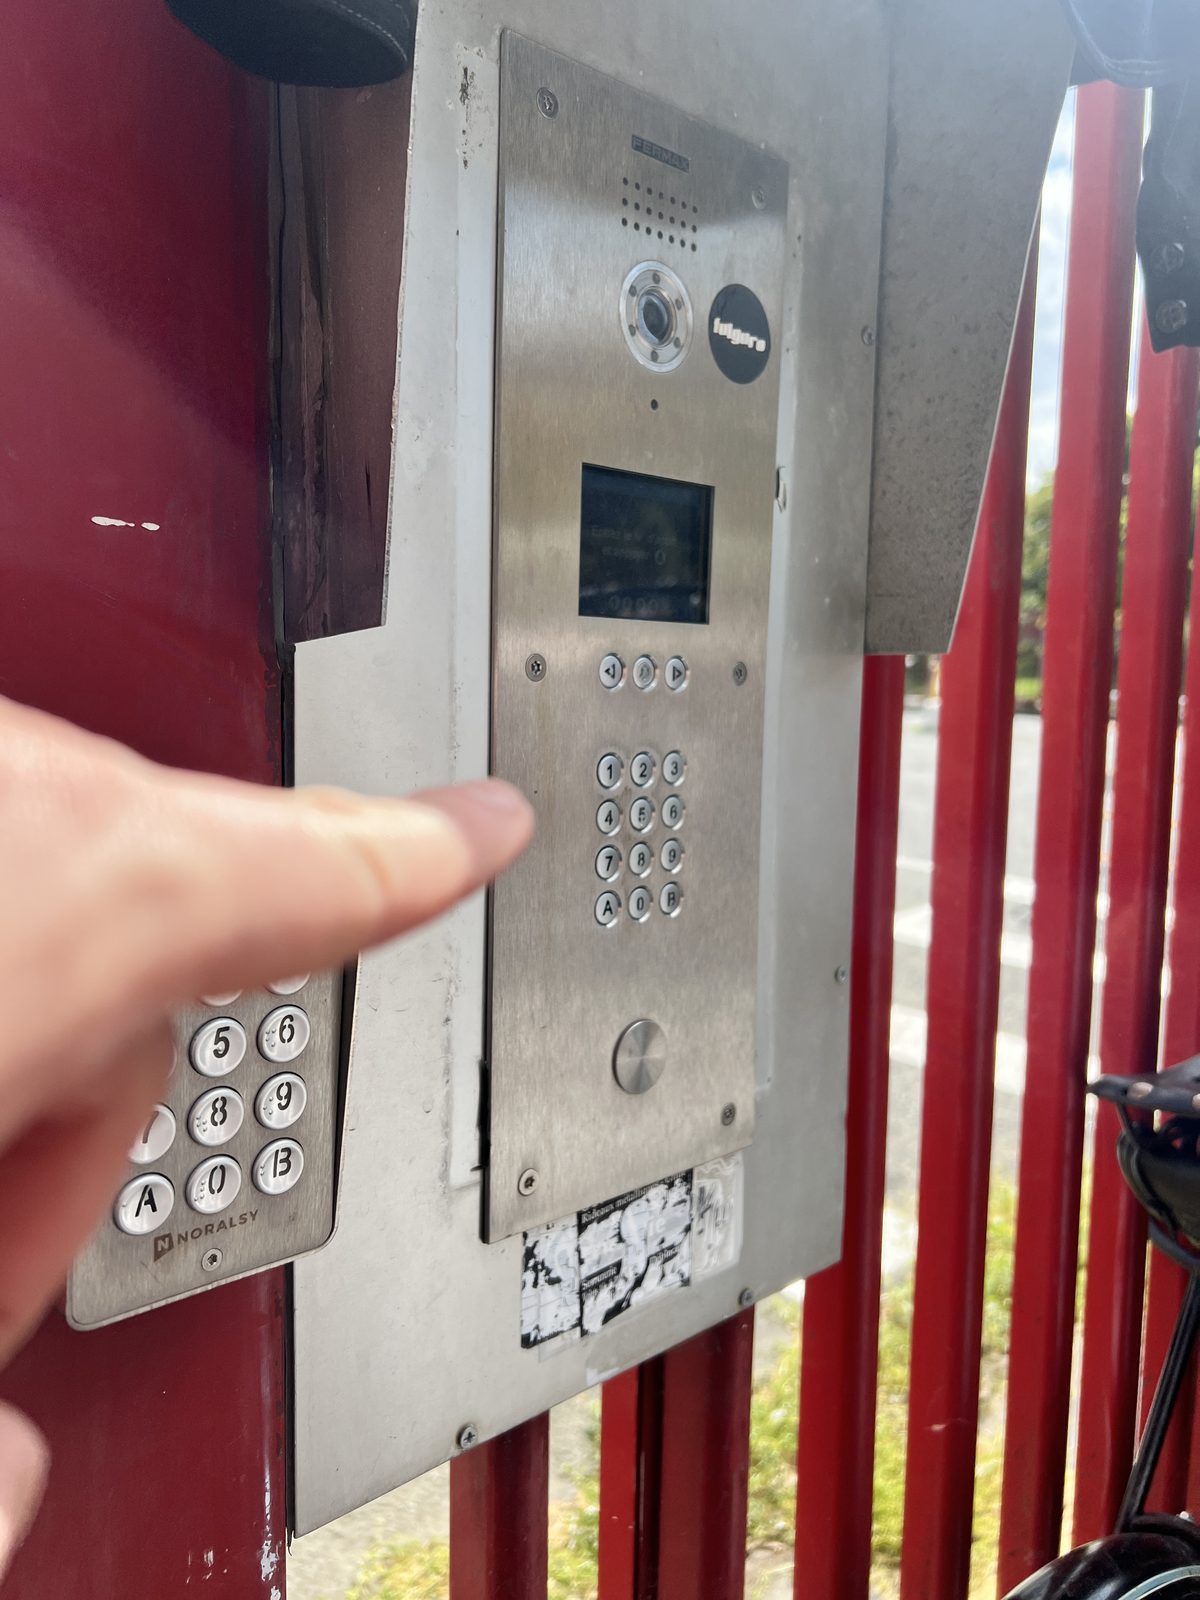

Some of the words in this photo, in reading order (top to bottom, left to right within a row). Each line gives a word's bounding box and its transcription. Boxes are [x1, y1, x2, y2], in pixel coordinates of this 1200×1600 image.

[606, 763, 614, 780] 1
[639, 762, 648, 778] 2
[670, 760, 679, 776] 3
[604, 809, 613, 826] 4
[638, 807, 646, 822] 5
[669, 804, 678, 820] 6
[605, 855, 613, 871] 7
[637, 852, 646, 867] 8
[668, 848, 676, 863] 9
[602, 900, 613, 916] A
[636, 896, 644, 911] 0
[212, 1026, 230, 1059] 5
[278, 1014, 295, 1044] 6
[211, 1096, 227, 1127] 8
[275, 1081, 292, 1111] 9
[135, 1183, 158, 1218] A
[208, 1164, 226, 1195] 0
[272, 1147, 292, 1178] B
[177, 1209, 258, 1245] NORALSY
